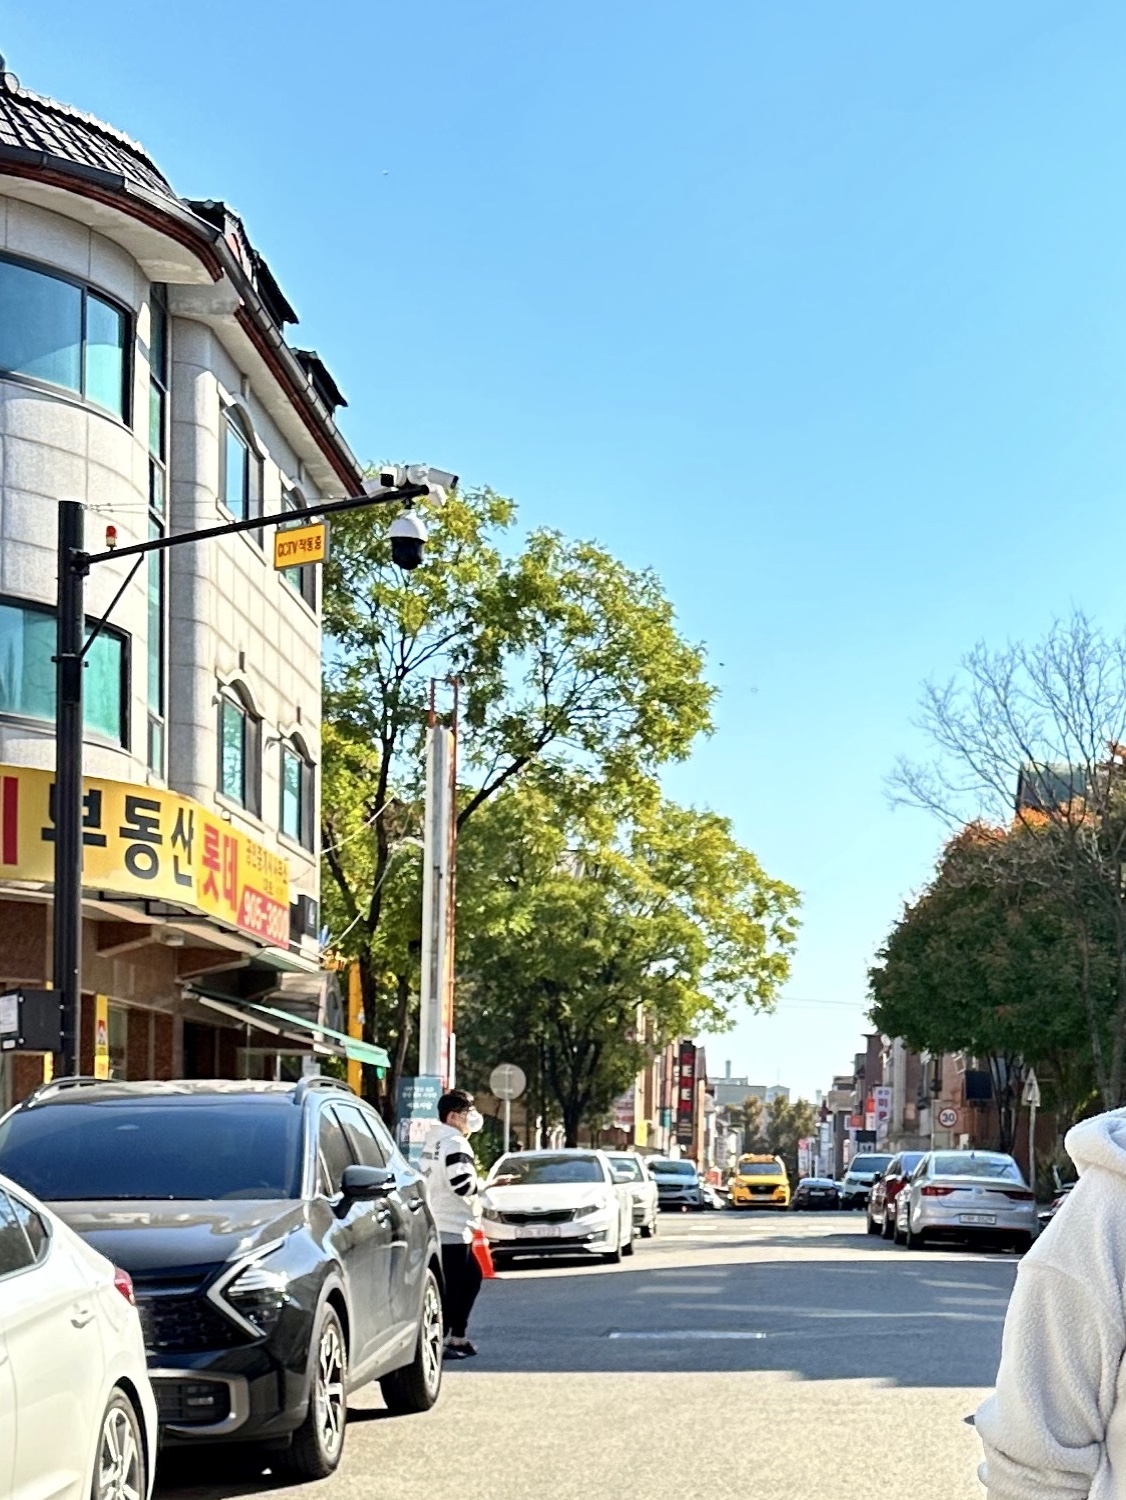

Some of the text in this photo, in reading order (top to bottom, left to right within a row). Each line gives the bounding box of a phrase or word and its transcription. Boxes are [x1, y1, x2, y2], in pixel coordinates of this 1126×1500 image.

[278, 541, 299, 557] CCTV
[202, 822, 239, 912] 롯데
[941, 1112, 955, 1123] 30
